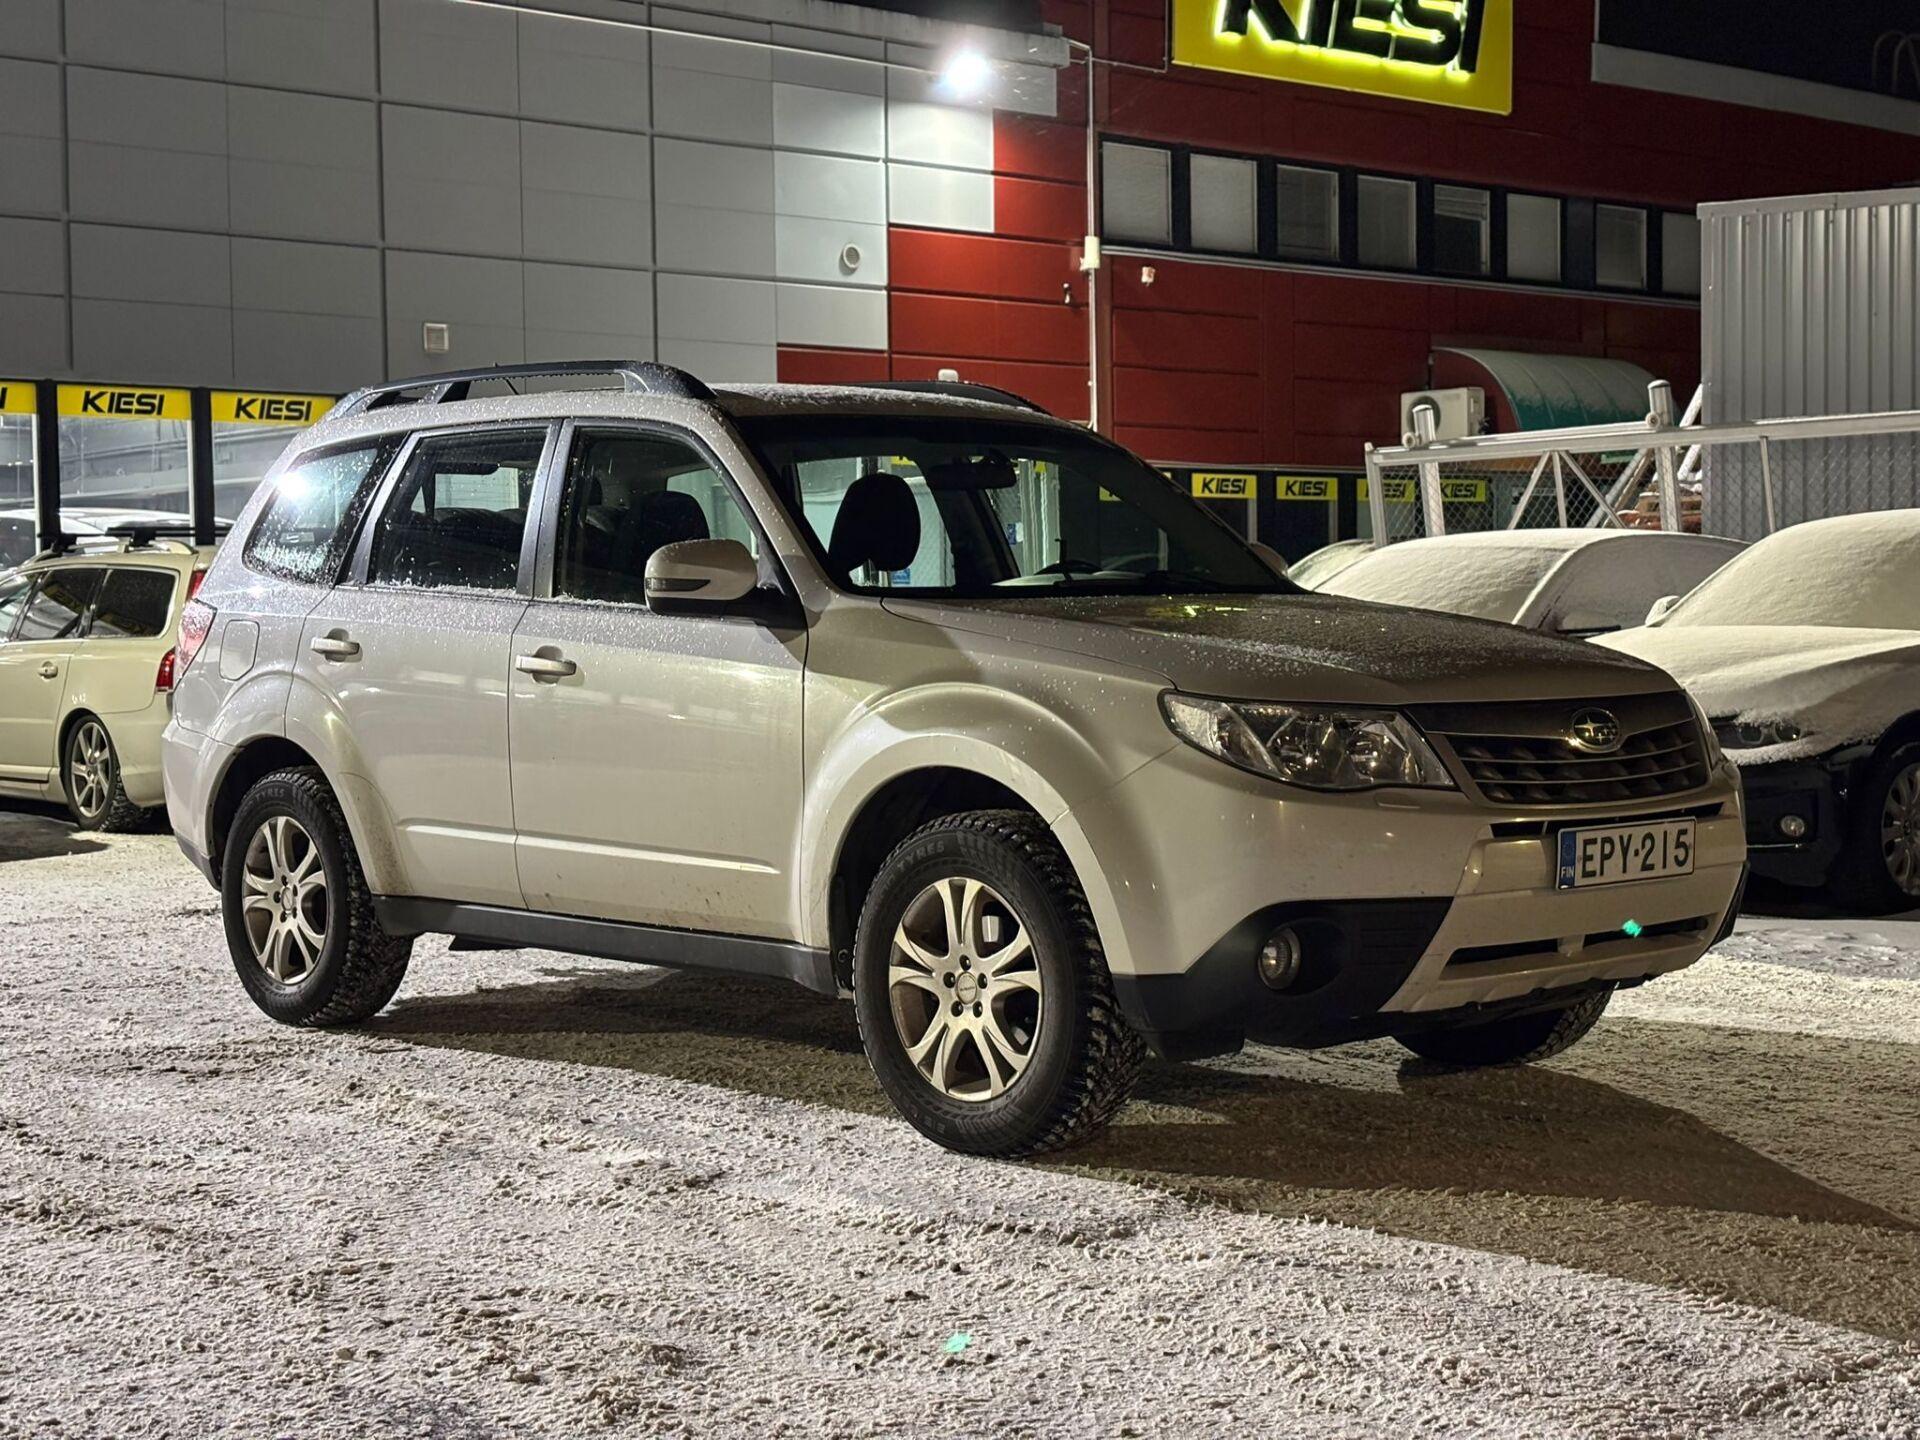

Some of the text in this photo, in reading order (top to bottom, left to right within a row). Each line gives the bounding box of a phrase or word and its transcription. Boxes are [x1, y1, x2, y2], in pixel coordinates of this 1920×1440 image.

[82, 390, 165, 416] KIESI
[234, 396, 313, 422] KIESI
[1202, 478, 1247, 495] KIESI
[1285, 479, 1328, 498] KIESI
[1560, 866, 1575, 879] FIN
